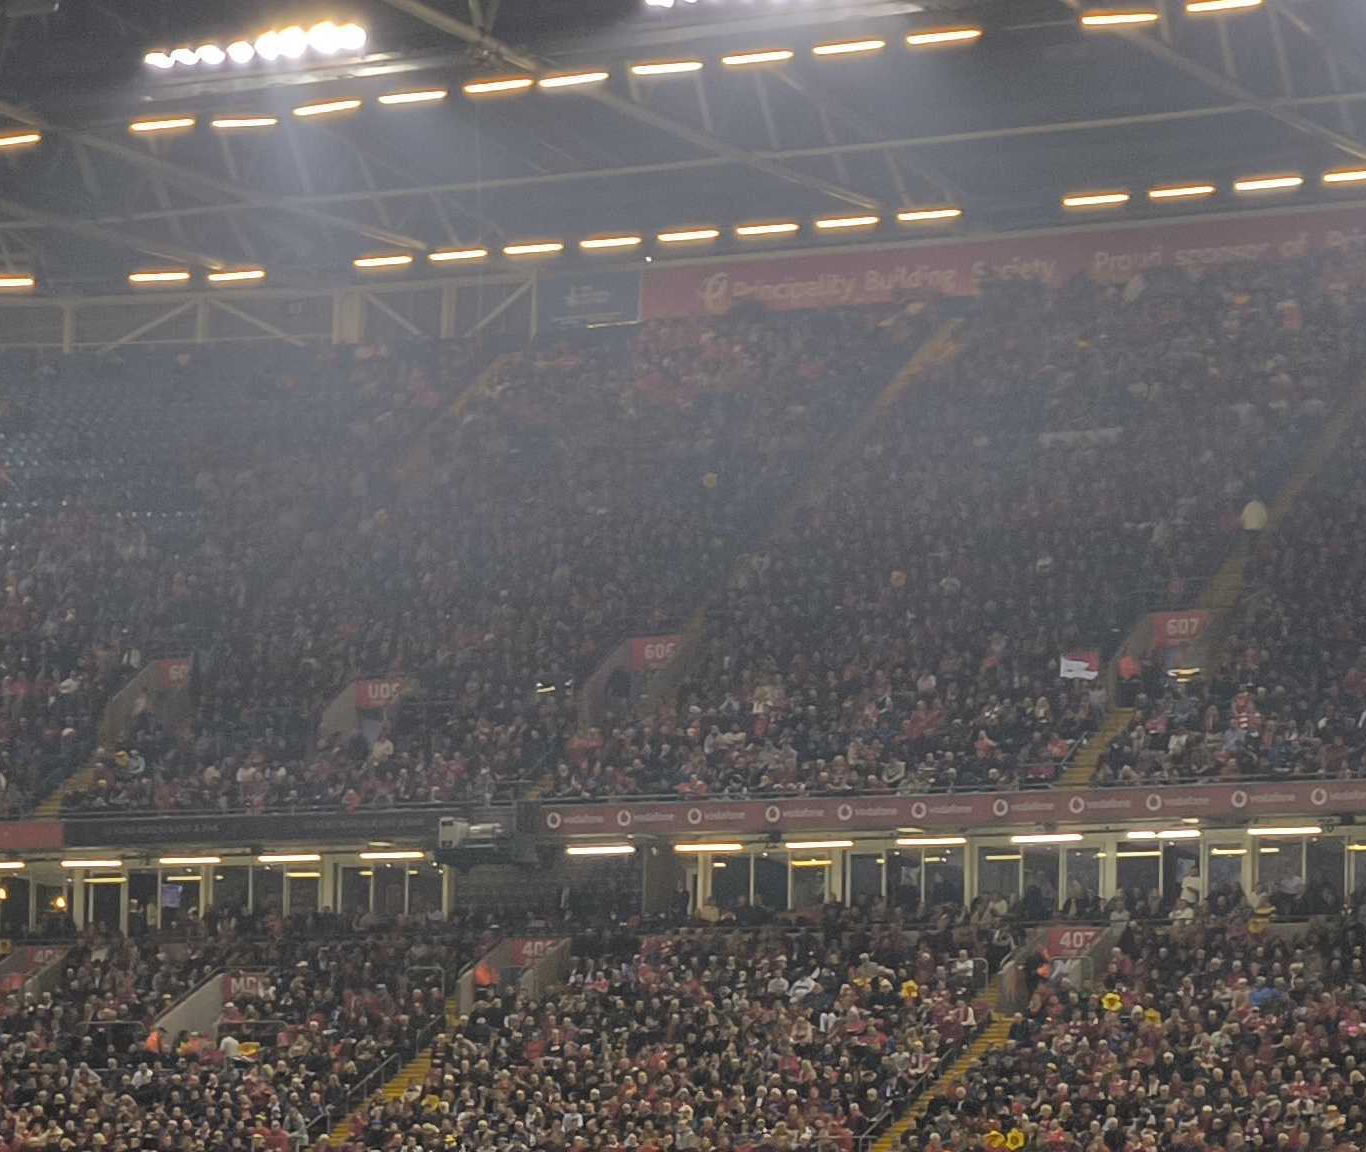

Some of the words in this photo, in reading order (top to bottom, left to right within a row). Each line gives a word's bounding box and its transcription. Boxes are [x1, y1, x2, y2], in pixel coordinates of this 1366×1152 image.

[864, 265, 957, 291] Building
[1166, 617, 1199, 635] 607
[523, 939, 555, 955] 40
